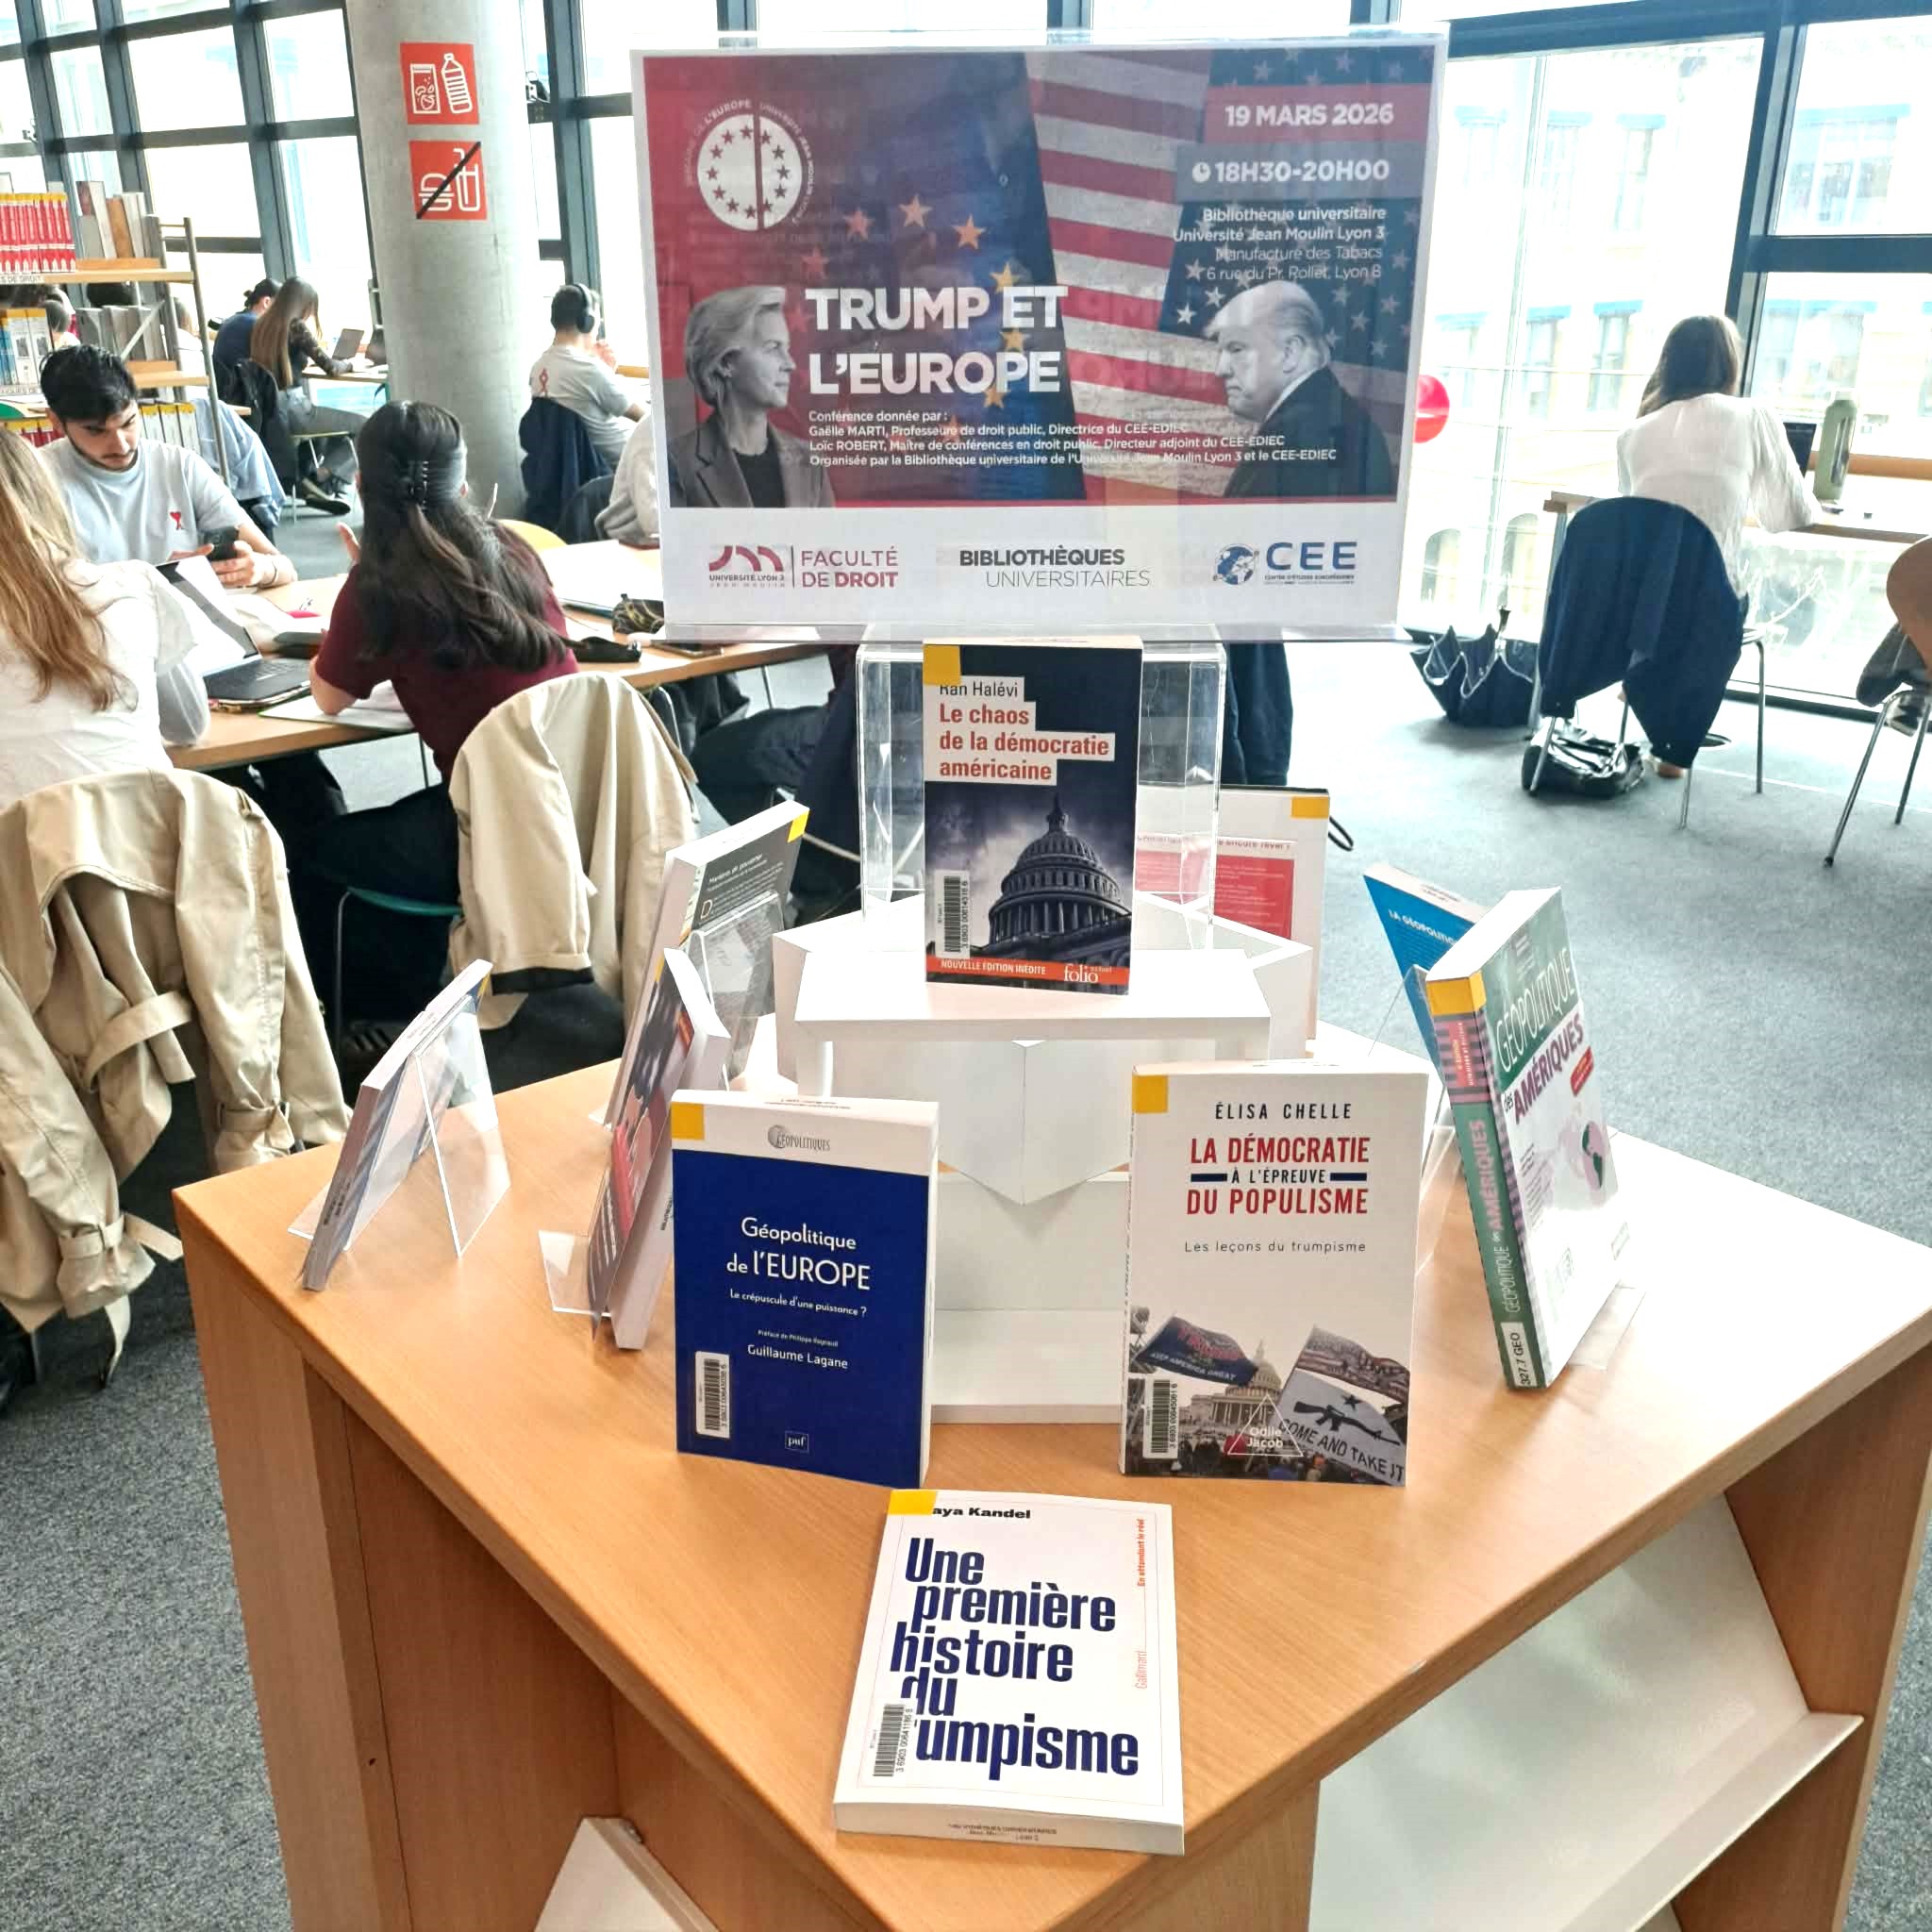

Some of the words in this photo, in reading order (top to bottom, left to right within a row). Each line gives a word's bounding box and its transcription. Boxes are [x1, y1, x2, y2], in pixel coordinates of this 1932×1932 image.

[1225, 105, 1250, 126] 19
[1256, 105, 1326, 125] MARS
[1332, 103, 1394, 125] 2026
[1214, 160, 1390, 183] 18H30-20H00
[1203, 208, 1294, 224] Bibliothèque
[1298, 207, 1386, 222] universitaire
[1173, 227, 1244, 242] Université
[1248, 227, 1281, 242] Jean
[1286, 227, 1333, 241] Moulin
[1338, 226, 1372, 243] Lyon
[1376, 226, 1385, 240] 3
[1216, 247, 1303, 261] Manufacture
[1306, 246, 1331, 259] des
[1335, 246, 1382, 258] Tabacs
[1207, 267, 1216, 279] 6
[1220, 270, 1243, 279] rue
[1245, 267, 1264, 279] du
[1335, 265, 1368, 282] Lyon
[1372, 266, 1382, 278] 8
[805, 288, 990, 330] TRUMP
[1003, 286, 1068, 328] ET
[808, 351, 1060, 394] L'EUROPE
[808, 410, 874, 423] Conférence
[876, 409, 920, 422] donnée
[923, 412, 941, 424] par
[808, 425, 844, 437] Gaëlle
[847, 426, 889, 438] MARTI,
[891, 425, 958, 438] Professeure
[959, 425, 974, 436] de
[977, 425, 1007, 436] droit
[1048, 424, 1104, 436] Directrice
[1107, 424, 1122, 434] du
[809, 441, 834, 452] Loïc
[837, 441, 887, 453] ROBERT,
[891, 440, 925, 451] Maître
[927, 440, 942, 451] de
[945, 440, 1014, 451] conférences
[1016, 441, 1030, 450] en
[1033, 439, 1061, 450] droit
[1104, 438, 1157, 449] Directeur
[1159, 438, 1201, 450] adjoint
[1202, 438, 1217, 448] du
[1221, 436, 1285, 447] CEE-EDIEC
[809, 455, 867, 468] Organisée
[870, 457, 889, 468] par
[891, 455, 902, 465] la
[904, 454, 976, 467] Bibliothèque
[978, 454, 1047, 466] universitaire
[1050, 453, 1065, 464] de
[1163, 452, 1201, 462] Moulin
[1204, 450, 1233, 463] Lyon
[1235, 452, 1242, 461] 3
[1244, 451, 1257, 461] et
[1259, 451, 1269, 460] le
[1272, 449, 1337, 460] CEE-EDIEC
[802, 545, 898, 566] FACULTÉ
[959, 545, 1125, 567] BIBLIOTHÈQUES
[1266, 541, 1357, 570] CEE
[802, 572, 830, 588] DE
[835, 571, 899, 588] DROIT
[986, 570, 1150, 588] UNIVERSITAIRES
[940, 685, 968, 696] Ran
[973, 682, 1018, 697] Halévi
[940, 703, 963, 724] Le
[969, 704, 1029, 725] chaos
[940, 730, 963, 750] de
[971, 731, 988, 751] la
[994, 731, 1109, 756] démocratie
[940, 758, 1052, 780] américaine
[1388, 908, 1401, 922] LA
[941, 960, 982, 971] NOUVELLE
[1064, 963, 1099, 983] folio
[1496, 947, 1575, 1072] GÉOPOLITIQUE
[1512, 1011, 1584, 1124] AMÉRIQUES
[1215, 1101, 1268, 1120] ÉLISA
[1283, 1104, 1352, 1120] CHELLE
[775, 1134, 830, 1152] GÉOPOLITIQUES
[1191, 1138, 1217, 1164] LA
[1227, 1133, 1370, 1164] DÉMOCRATIE
[1231, 1167, 1241, 1184] À
[1250, 1167, 1325, 1183] L'ÉPREUVE
[1469, 1120, 1504, 1230] AMÉRIQUES
[1187, 1189, 1218, 1215] DU
[1229, 1189, 1368, 1214] POPULISME
[741, 1217, 857, 1250] Géopolitique
[1185, 1241, 1208, 1253] Les
[1216, 1241, 1260, 1254] leçons
[1268, 1241, 1285, 1252] du
[1291, 1241, 1366, 1255] trumpisme
[726, 1253, 747, 1274] de
[754, 1251, 870, 1291] l'EUROPE
[1494, 1245, 1520, 1313] GÉOPOLITIQUE
[730, 1289, 740, 1299] Le
[741, 1292, 787, 1307] crépuscule
[790, 1296, 813, 1309] d'une
[815, 1302, 858, 1316] puissance
[860, 1306, 867, 1318] ?
[1510, 1332, 1524, 1356] GEO
[747, 1344, 804, 1362] Guillaume
[807, 1353, 848, 1369] Lagane
[788, 1436, 807, 1447] puf
[1250, 1426, 1282, 1437] Odile
[1247, 1437, 1283, 1449] Jacob
[1278, 1418, 1317, 1441] COME
[1317, 1436, 1347, 1457] AND
[1350, 1447, 1386, 1474] TAKE
[1391, 1465, 1405, 1481] IT
[932, 1507, 964, 1519] aya
[969, 1507, 1031, 1520] Kandel
[905, 1538, 985, 1585] Une
[911, 1581, 1116, 1633] première
[890, 1622, 1074, 1682] histoire
[1135, 1650, 1148, 1690] Gallimard
[901, 1667, 958, 1716] du
[914, 1713, 1139, 1781] umpisme
